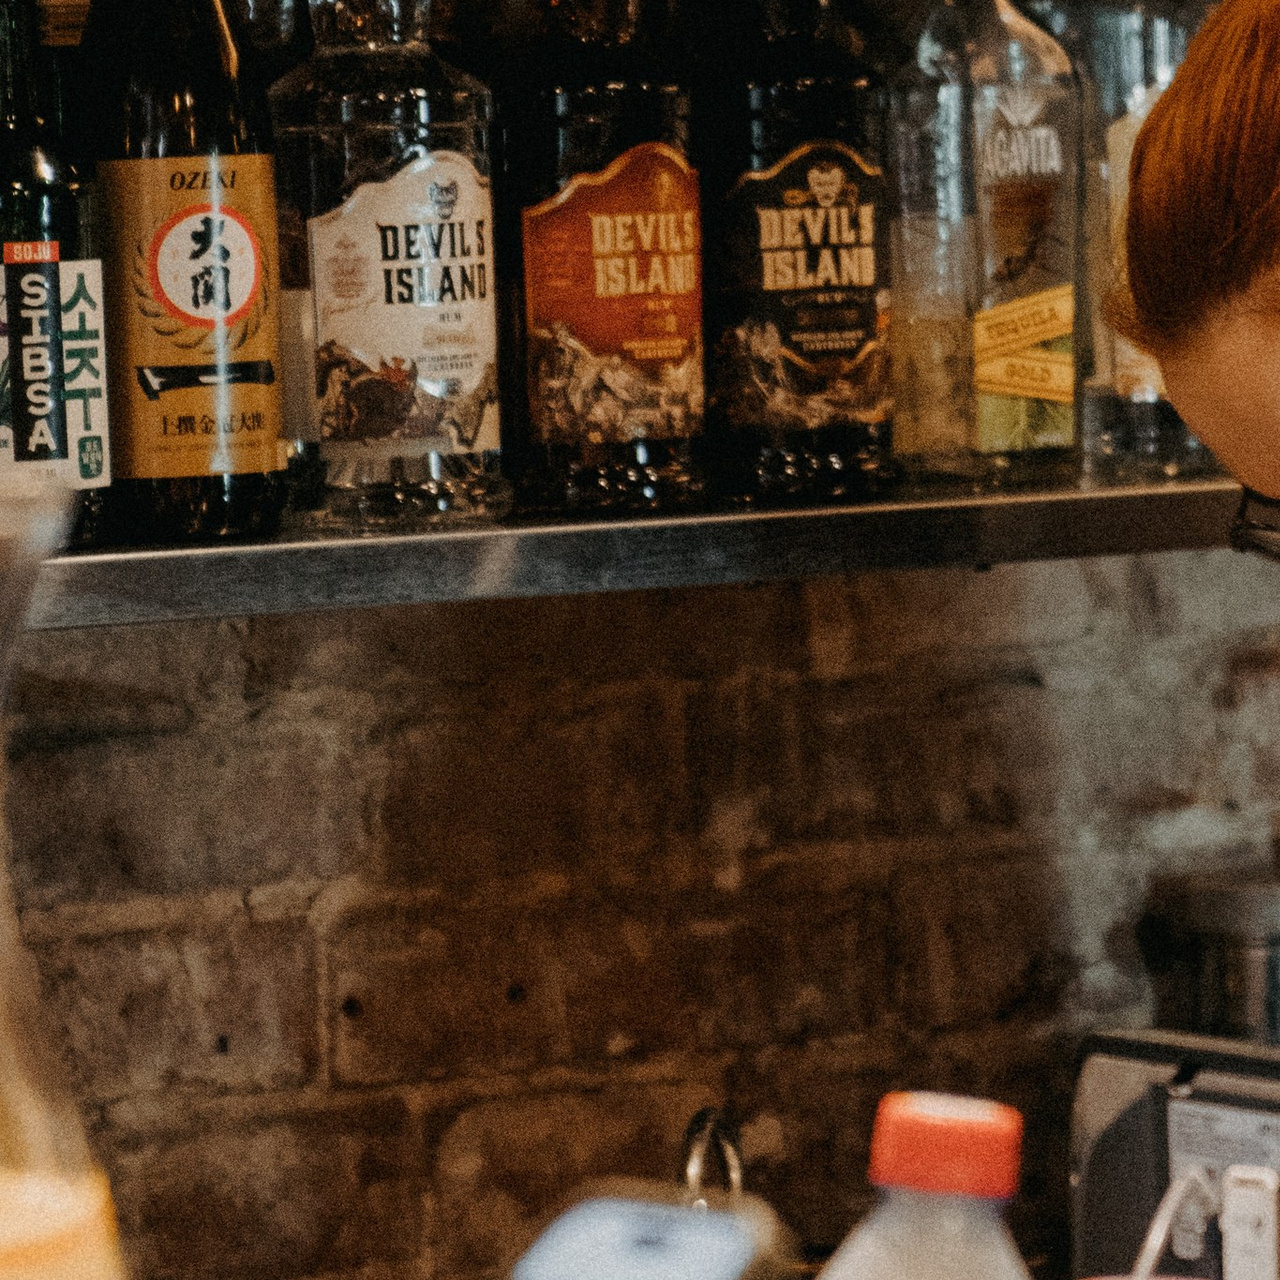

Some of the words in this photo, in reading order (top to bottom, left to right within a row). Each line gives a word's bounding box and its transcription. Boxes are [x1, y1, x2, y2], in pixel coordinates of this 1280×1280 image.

[13, 244, 51, 262] SOJU
[762, 246, 875, 291] ISLAND
[383, 263, 487, 305] ISLAND
[593, 254, 696, 298] ISLAND
[59, 272, 102, 432] 소주
